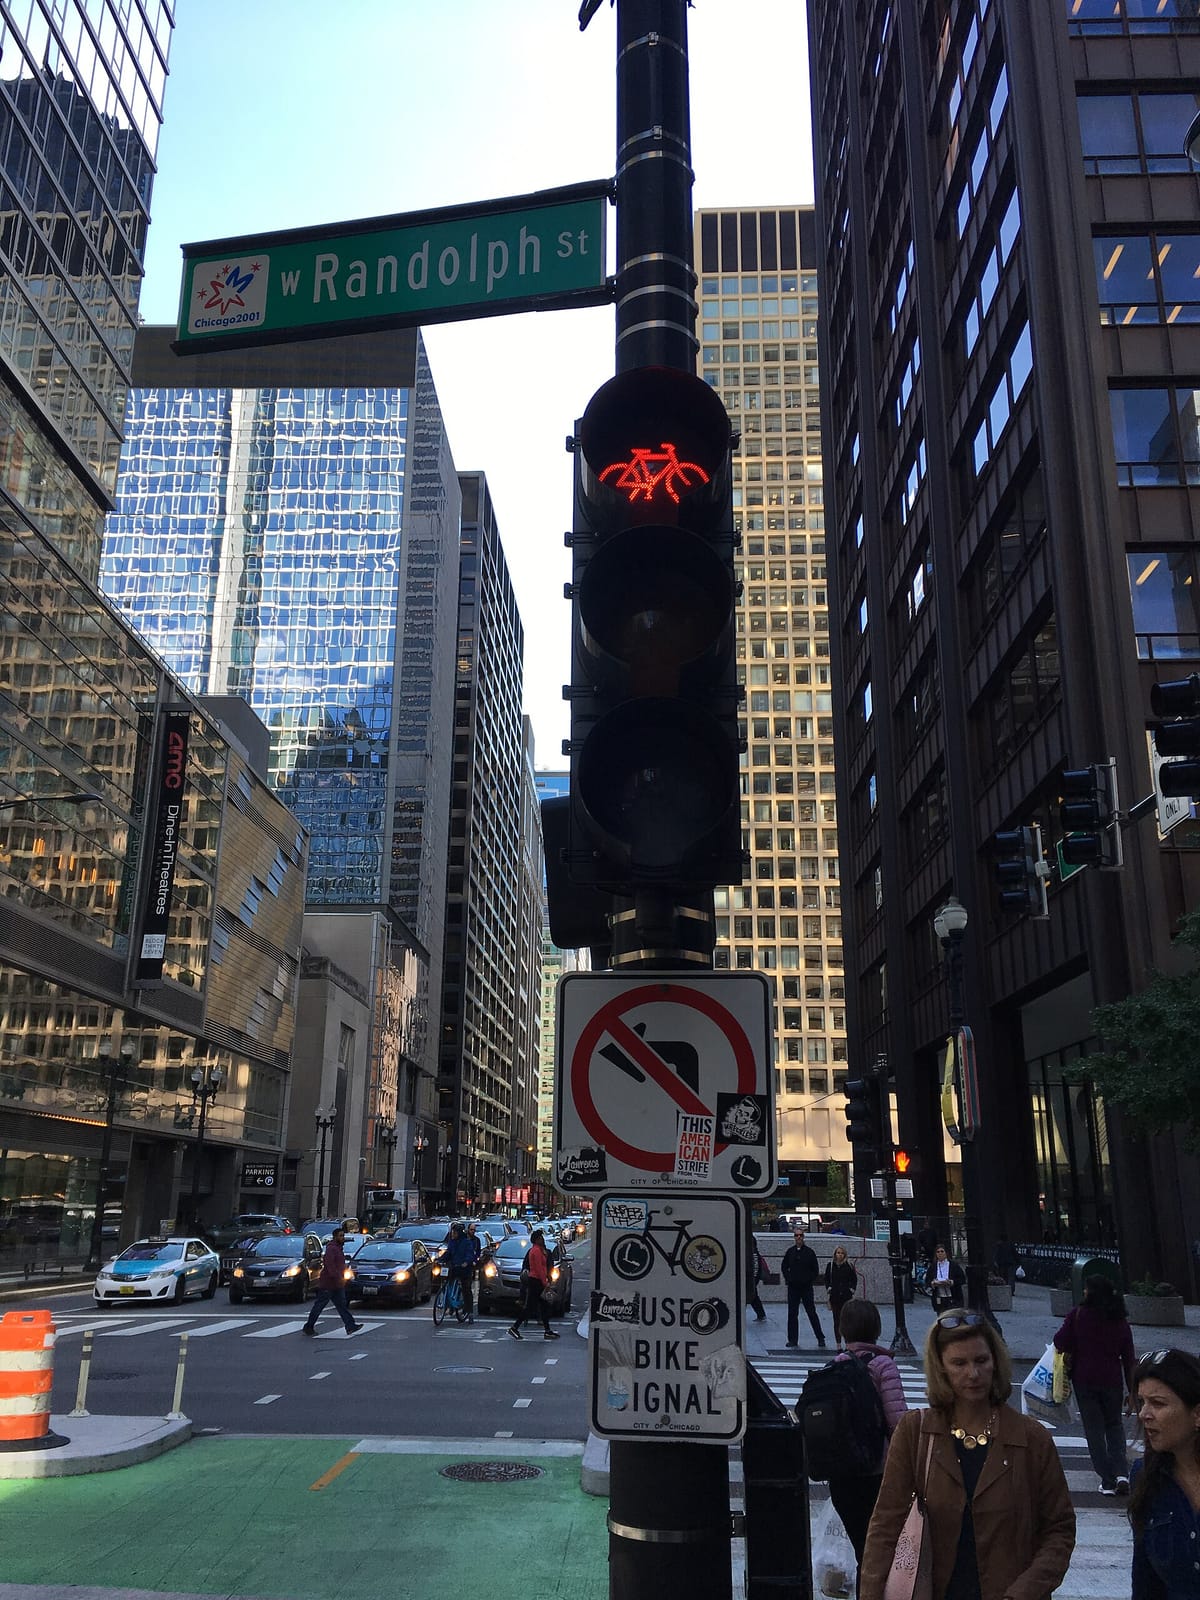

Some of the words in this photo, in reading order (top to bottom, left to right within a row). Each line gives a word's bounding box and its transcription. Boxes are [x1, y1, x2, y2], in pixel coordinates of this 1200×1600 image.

[313, 225, 541, 304] Randolph
[556, 228, 589, 259] St
[193, 310, 261, 329] Chicago2001
[681, 1116, 712, 1134] THIS
[680, 1133, 711, 1146] AMER
[678, 1145, 710, 1162] ICAN
[245, 1168, 275, 1176] PARKING
[678, 1160, 709, 1173] STRIFE
[641, 1296, 694, 1327] USE
[635, 1339, 699, 1371] BIKE
[616, 1382, 721, 1415] IGNAL
